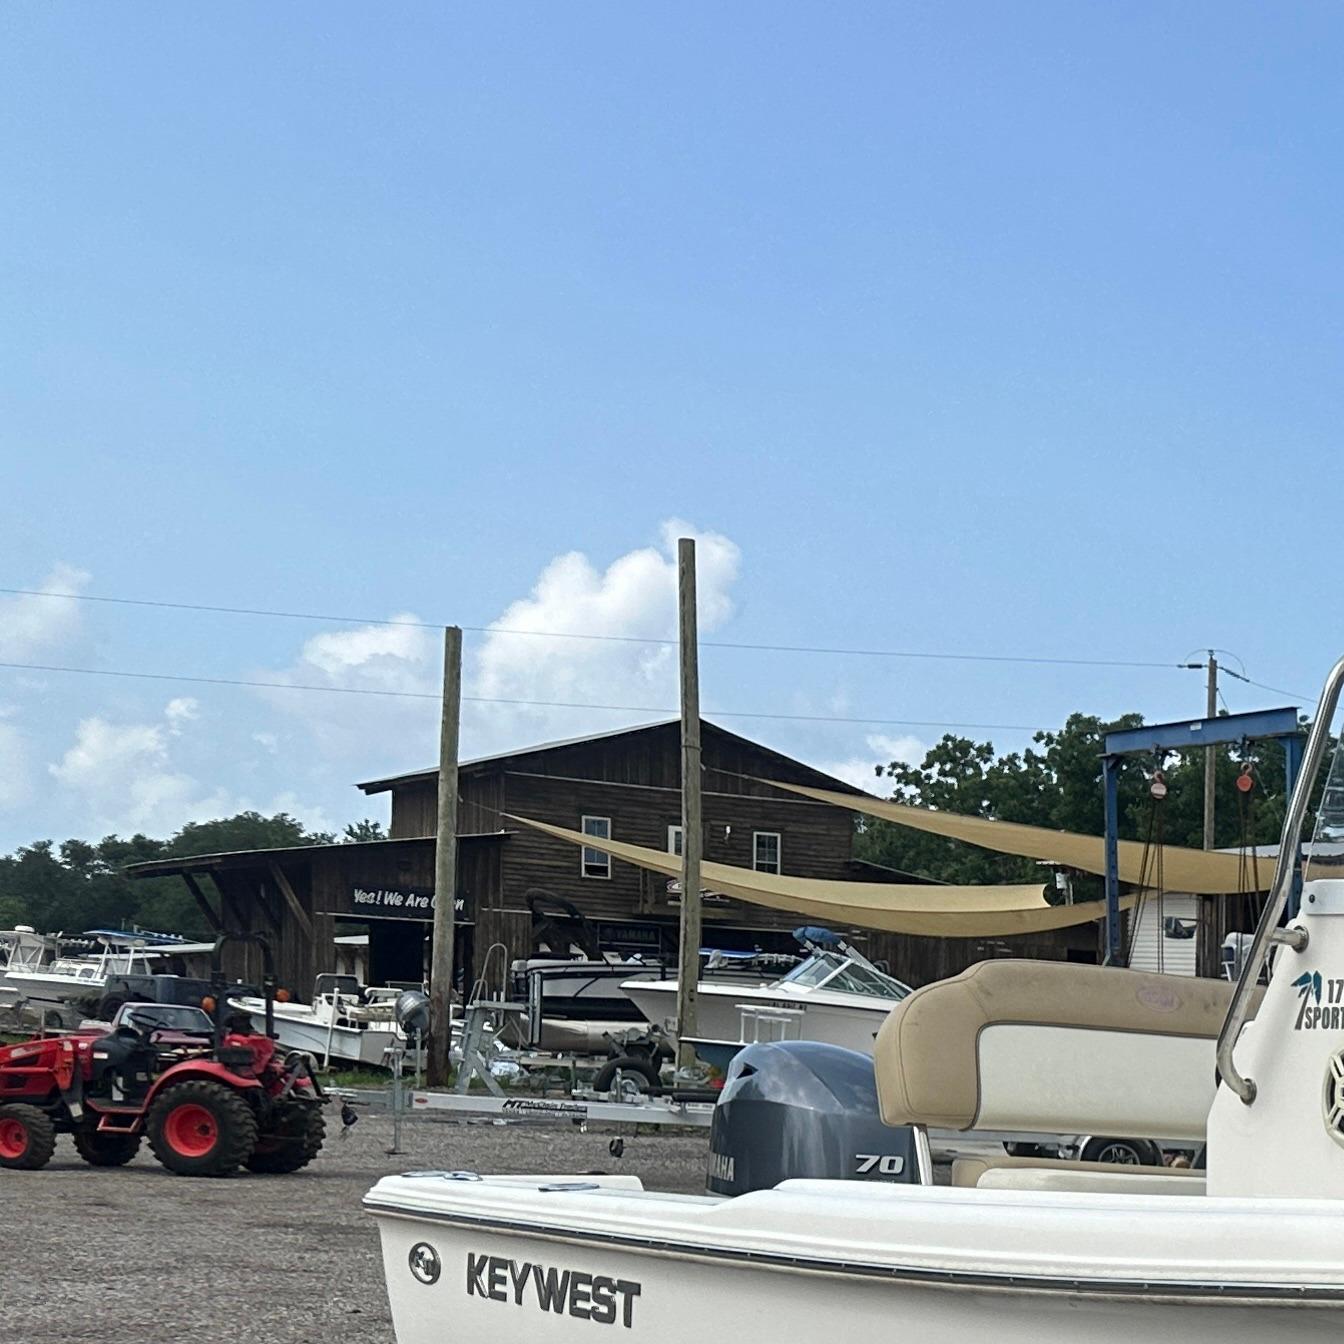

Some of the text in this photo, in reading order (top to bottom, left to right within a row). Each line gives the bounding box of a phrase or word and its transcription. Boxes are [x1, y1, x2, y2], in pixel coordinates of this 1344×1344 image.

[384, 891, 403, 906] We
[405, 893, 429, 908] Are
[855, 1154, 905, 1174] 70
